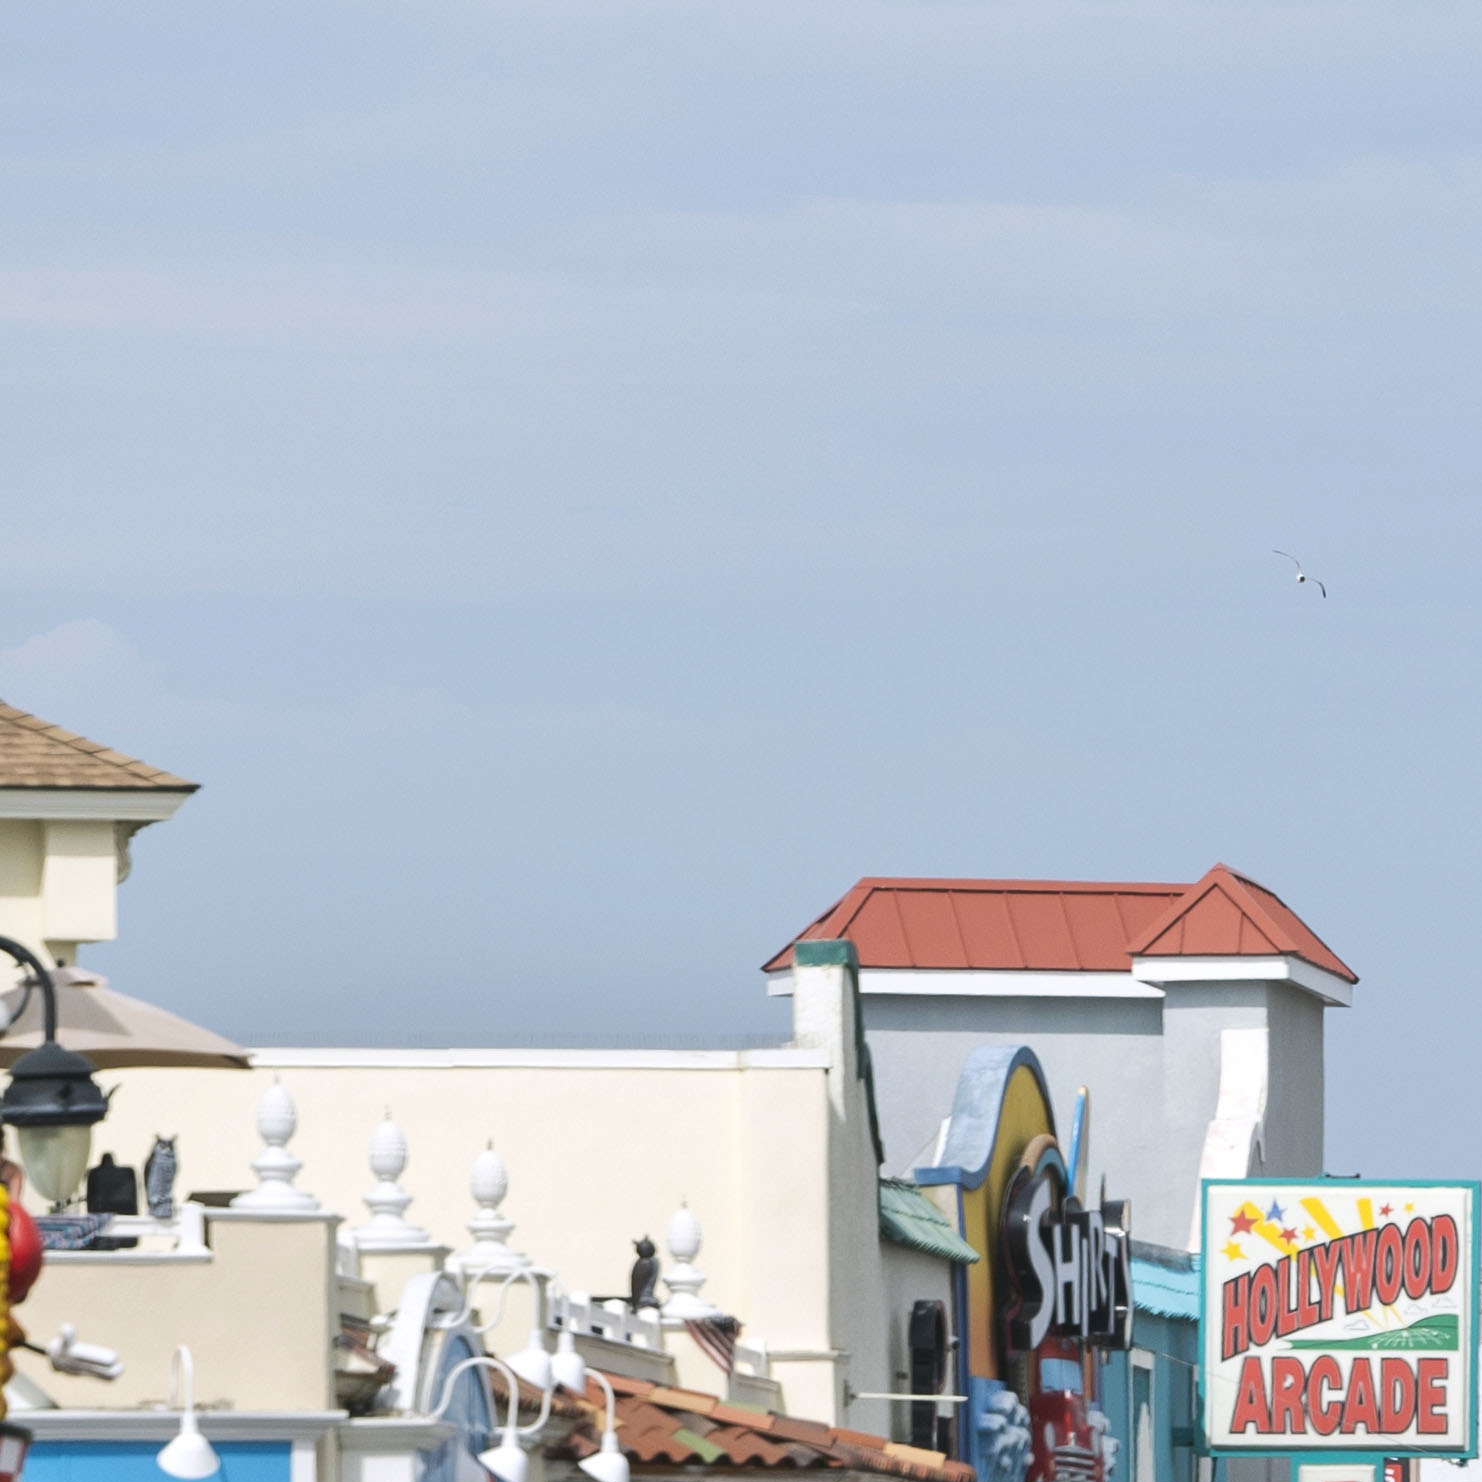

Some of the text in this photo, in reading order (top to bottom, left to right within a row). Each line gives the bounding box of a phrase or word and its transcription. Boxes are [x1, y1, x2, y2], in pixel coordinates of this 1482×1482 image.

[1026, 1179, 1134, 1349] SHIRT
[1221, 1214, 1459, 1362] HOLLYWOOD
[1229, 1354, 1449, 1435] ARCADE
